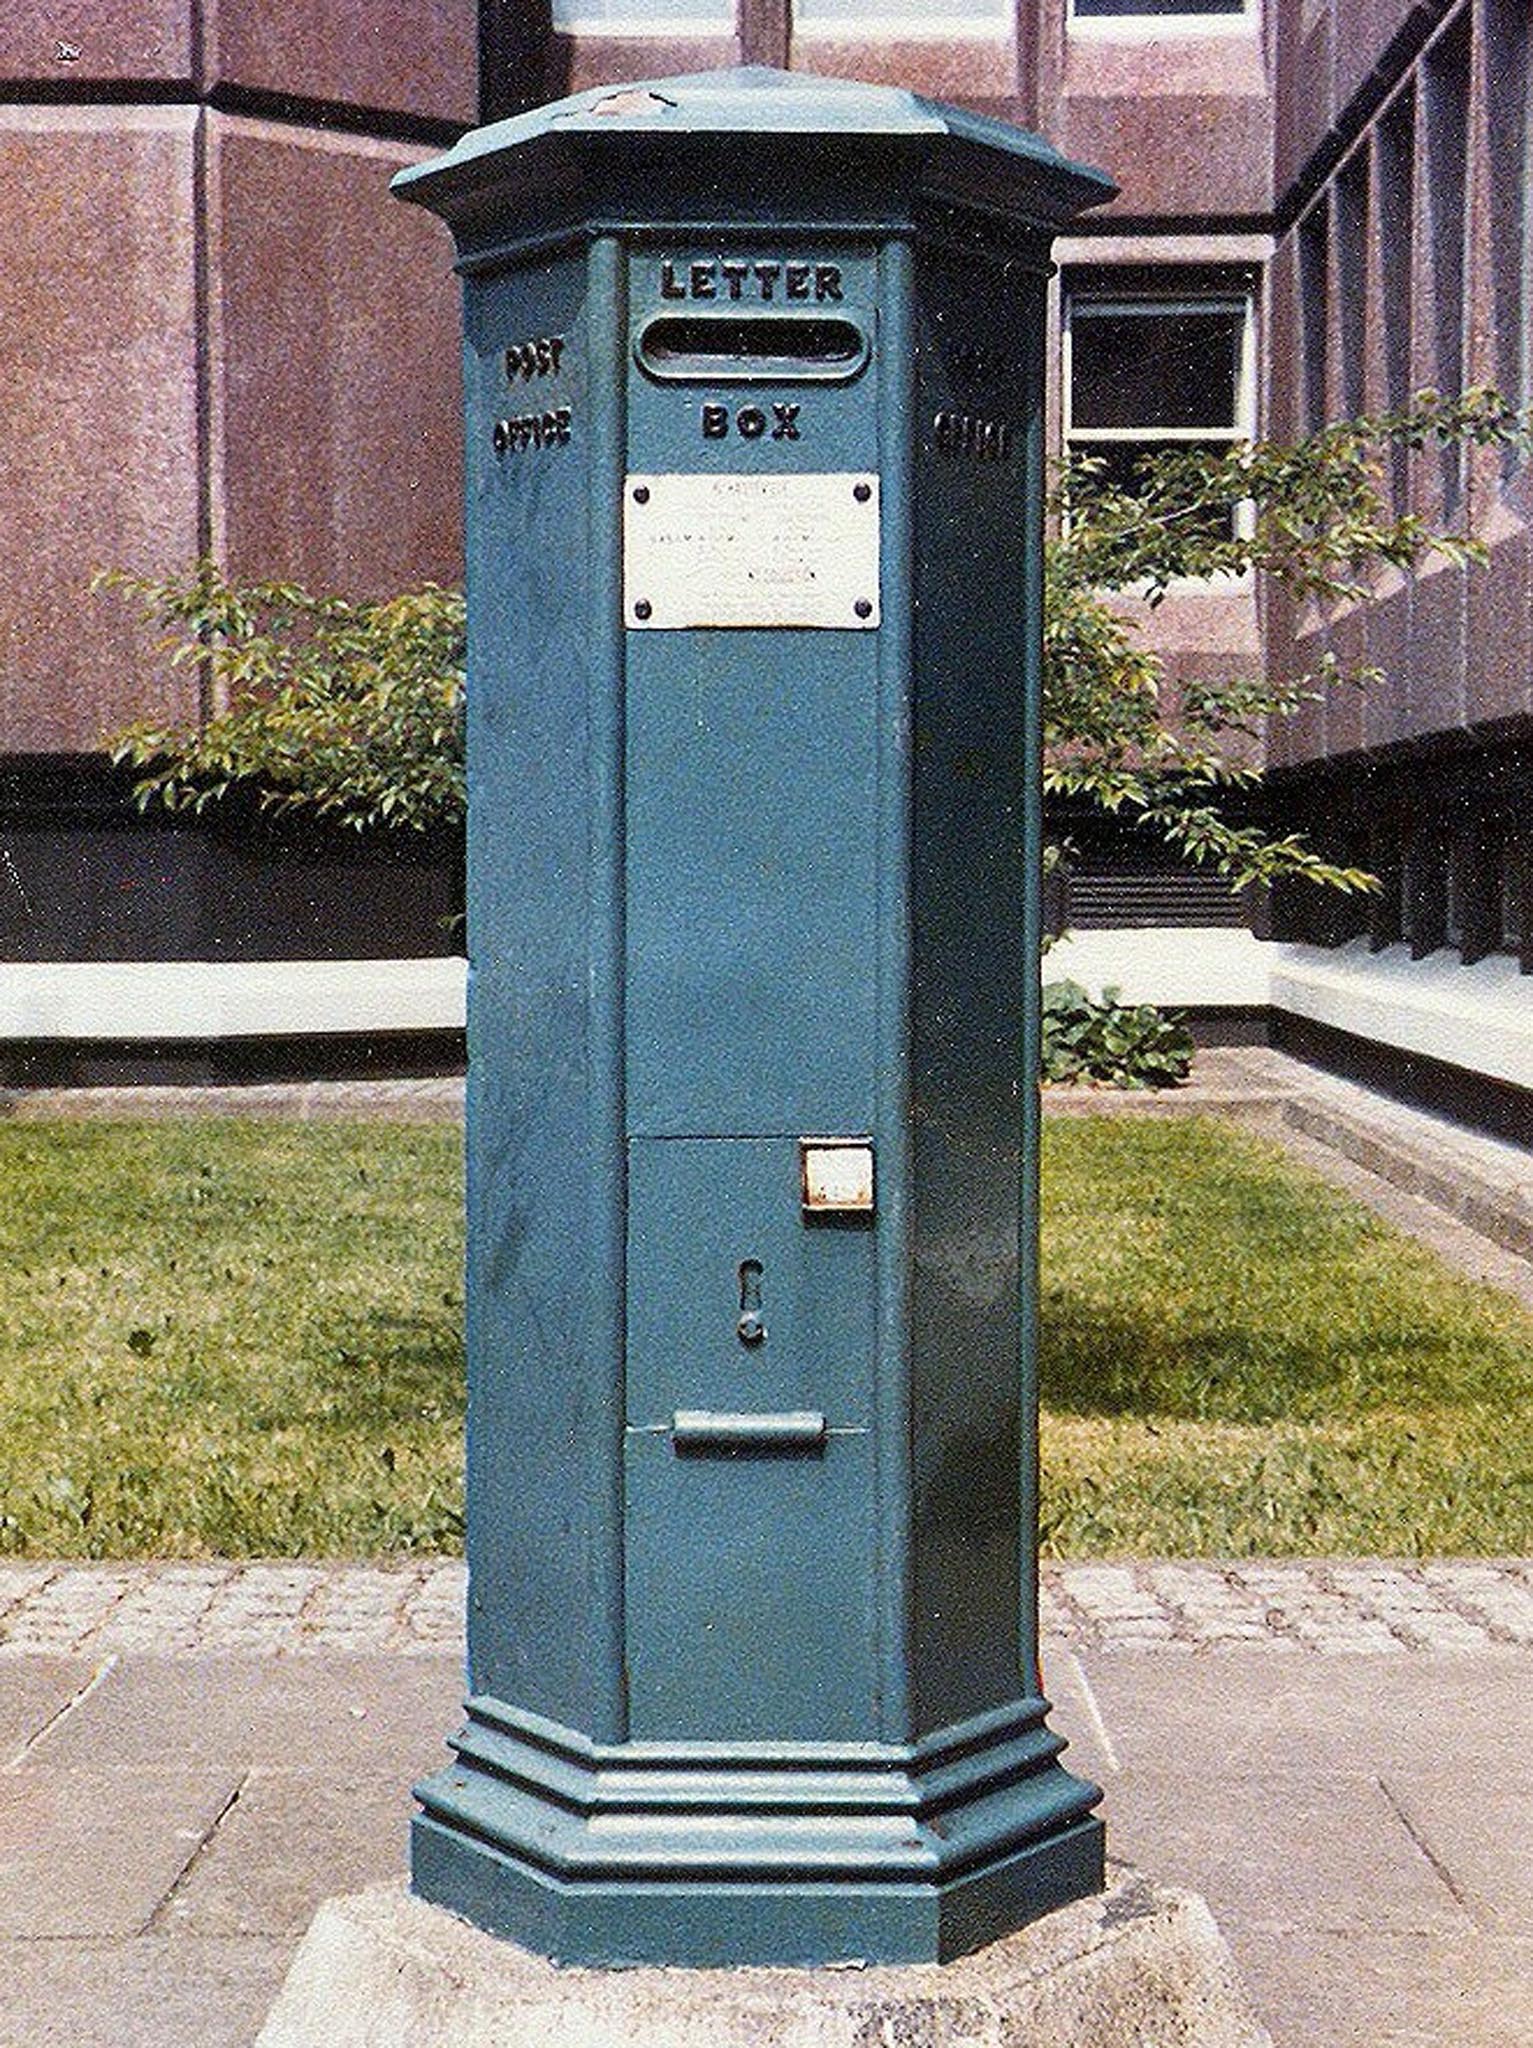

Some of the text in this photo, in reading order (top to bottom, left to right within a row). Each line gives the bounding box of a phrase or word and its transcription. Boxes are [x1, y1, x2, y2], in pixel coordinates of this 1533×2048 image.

[660, 260, 843, 301] LETTER
[505, 336, 564, 382] POST
[493, 406, 571, 454] OFFICE
[702, 402, 800, 440] BOX
